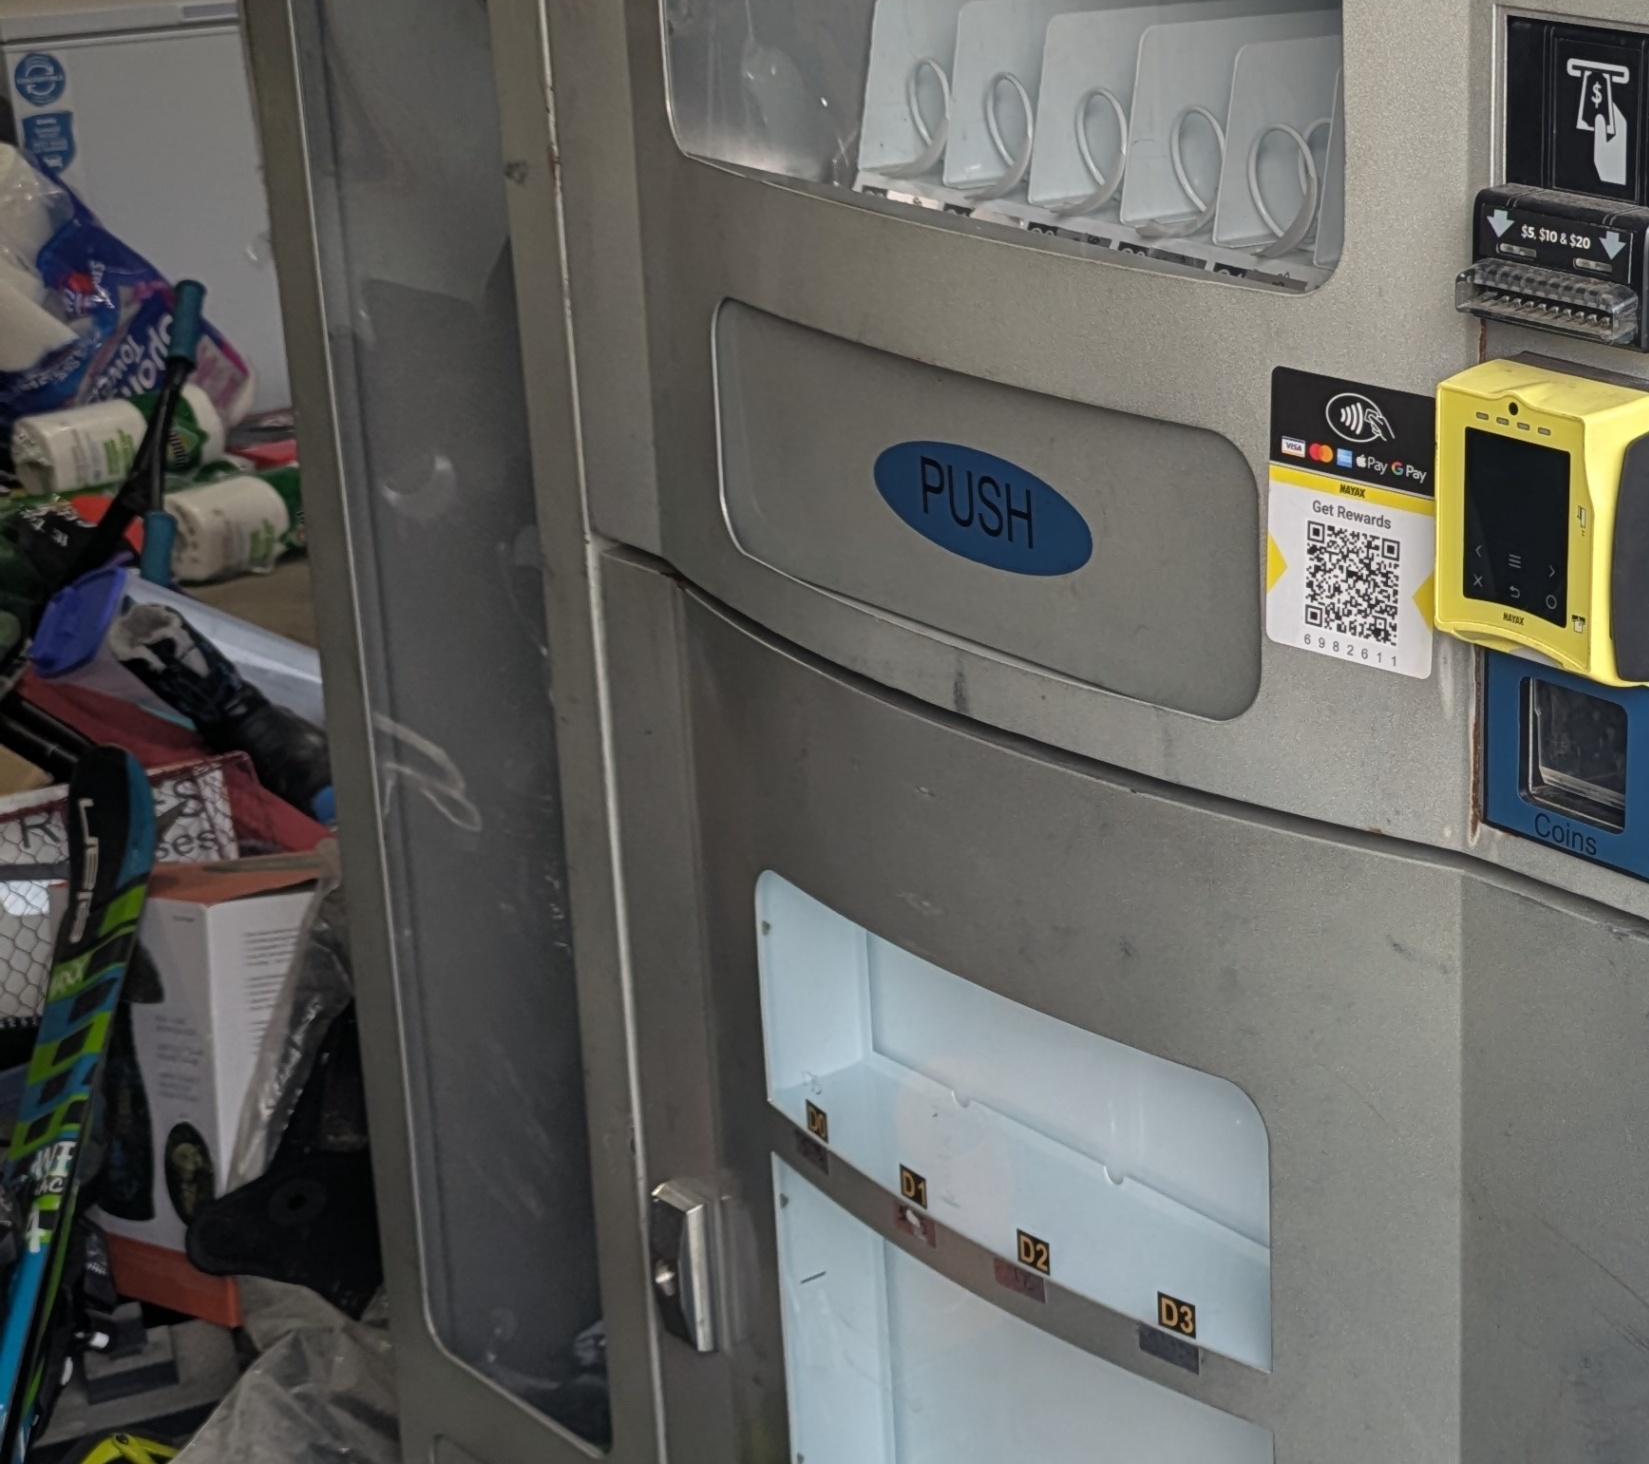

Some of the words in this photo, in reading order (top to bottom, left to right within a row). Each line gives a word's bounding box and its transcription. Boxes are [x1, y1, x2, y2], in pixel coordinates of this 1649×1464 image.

[1539, 227, 1557, 242] $10
[1560, 233, 1568, 245] &
[1570, 234, 1591, 249] $20
[1285, 442, 1302, 451] VISA
[1367, 456, 1388, 475] Pay
[1406, 465, 1427, 483] Pay
[920, 455, 1033, 549] PUSH
[1339, 484, 1366, 499] NAYAX
[1312, 500, 1334, 517] Get
[1337, 507, 1392, 530] Rewards
[1503, 612, 1524, 626] NAYAX
[1535, 813, 1597, 855] Coins
[809, 1106, 826, 1139] D0
[902, 1170, 926, 1206] D1
[1020, 1234, 1048, 1272] D2
[1161, 1296, 1194, 1334] D3
